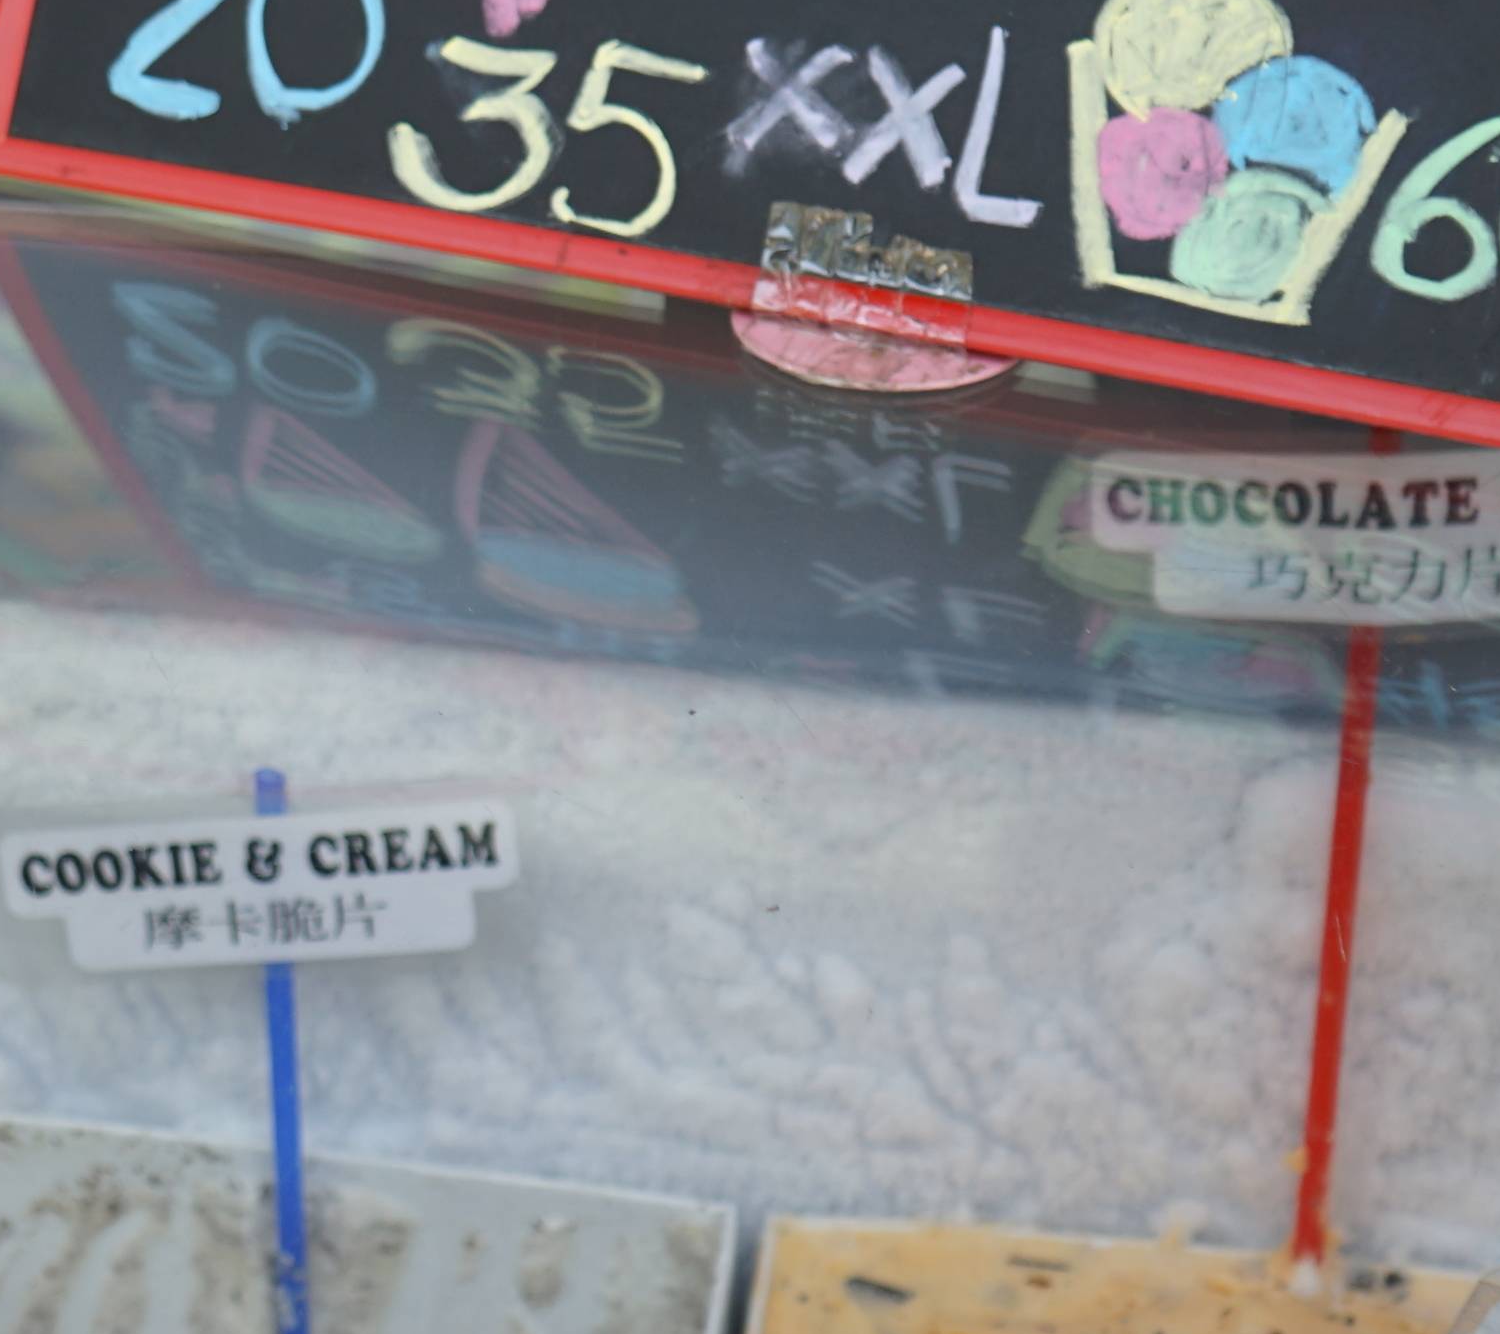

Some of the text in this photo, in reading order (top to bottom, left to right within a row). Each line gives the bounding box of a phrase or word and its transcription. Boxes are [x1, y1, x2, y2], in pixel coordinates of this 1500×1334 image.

[387, 34, 706, 240] 35
[725, 27, 1042, 229] XXL
[1105, 476, 1479, 529] CHOCOLATE
[20, 822, 501, 896] COOKIE & CREAM
